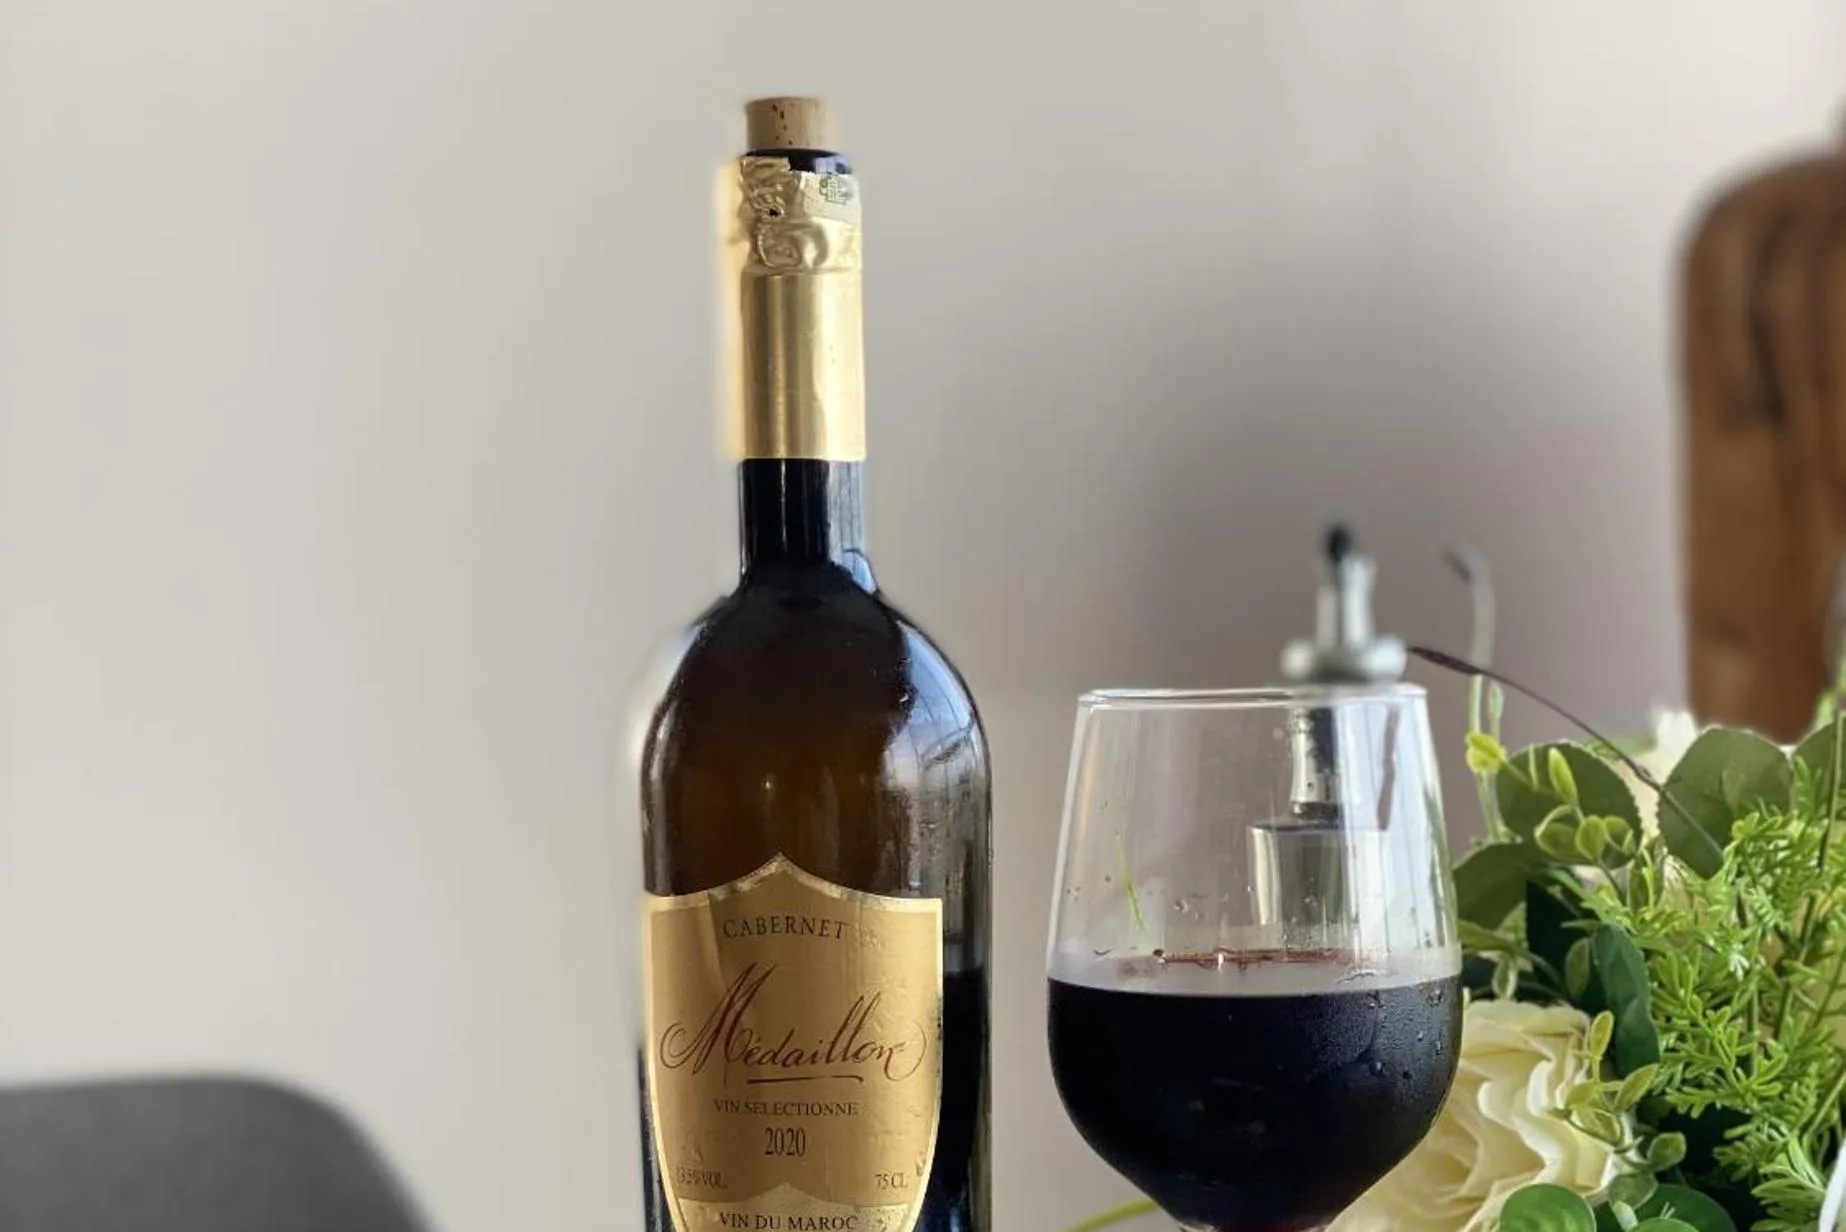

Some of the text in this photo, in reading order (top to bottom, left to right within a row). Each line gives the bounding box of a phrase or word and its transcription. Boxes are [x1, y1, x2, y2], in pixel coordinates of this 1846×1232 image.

[723, 915, 849, 940] CABERNET
[659, 961, 927, 1082] Médaillon
[714, 1099, 740, 1113] VIN
[764, 1127, 806, 1157] 2020
[720, 1212, 858, 1231] VIN DU MAROC
